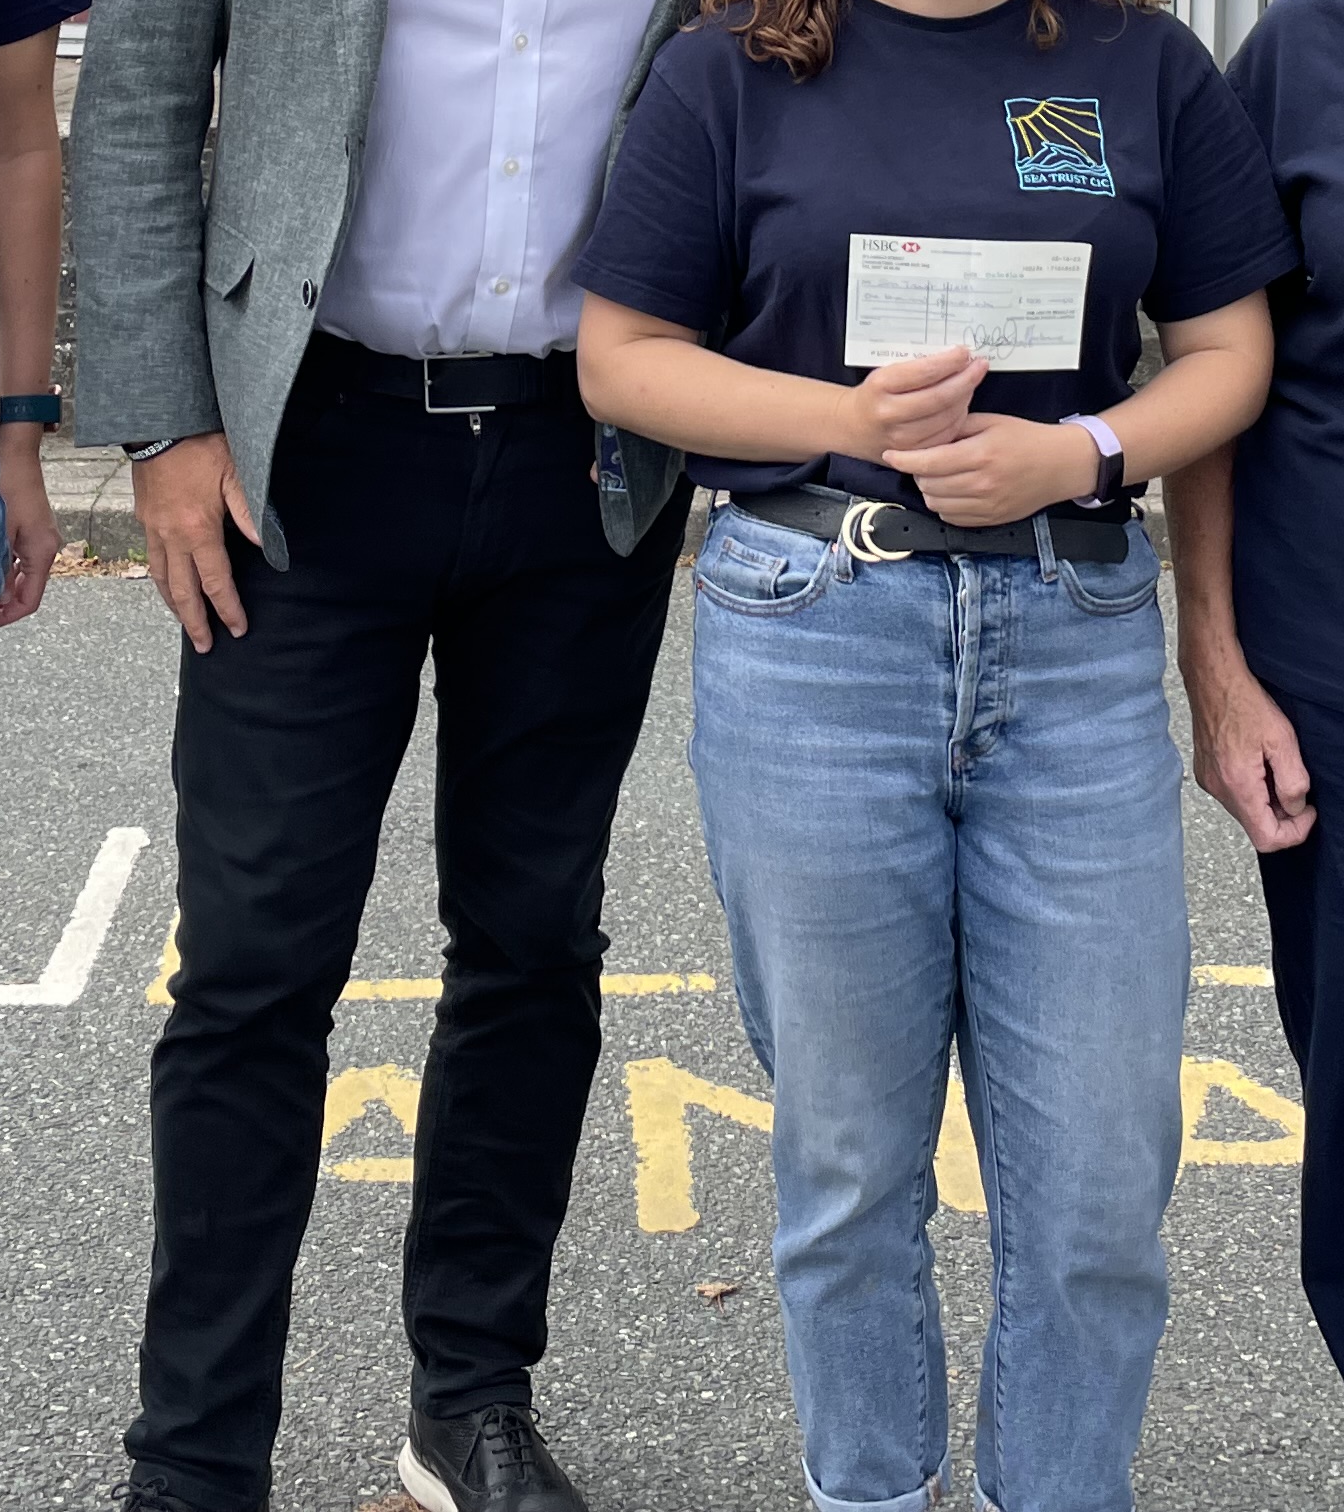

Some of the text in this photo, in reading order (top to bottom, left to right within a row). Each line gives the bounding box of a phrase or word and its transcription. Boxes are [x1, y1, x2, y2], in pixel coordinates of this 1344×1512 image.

[1024, 172, 1110, 188] SEA TRUST CIC
[862, 239, 899, 252] HSBC
